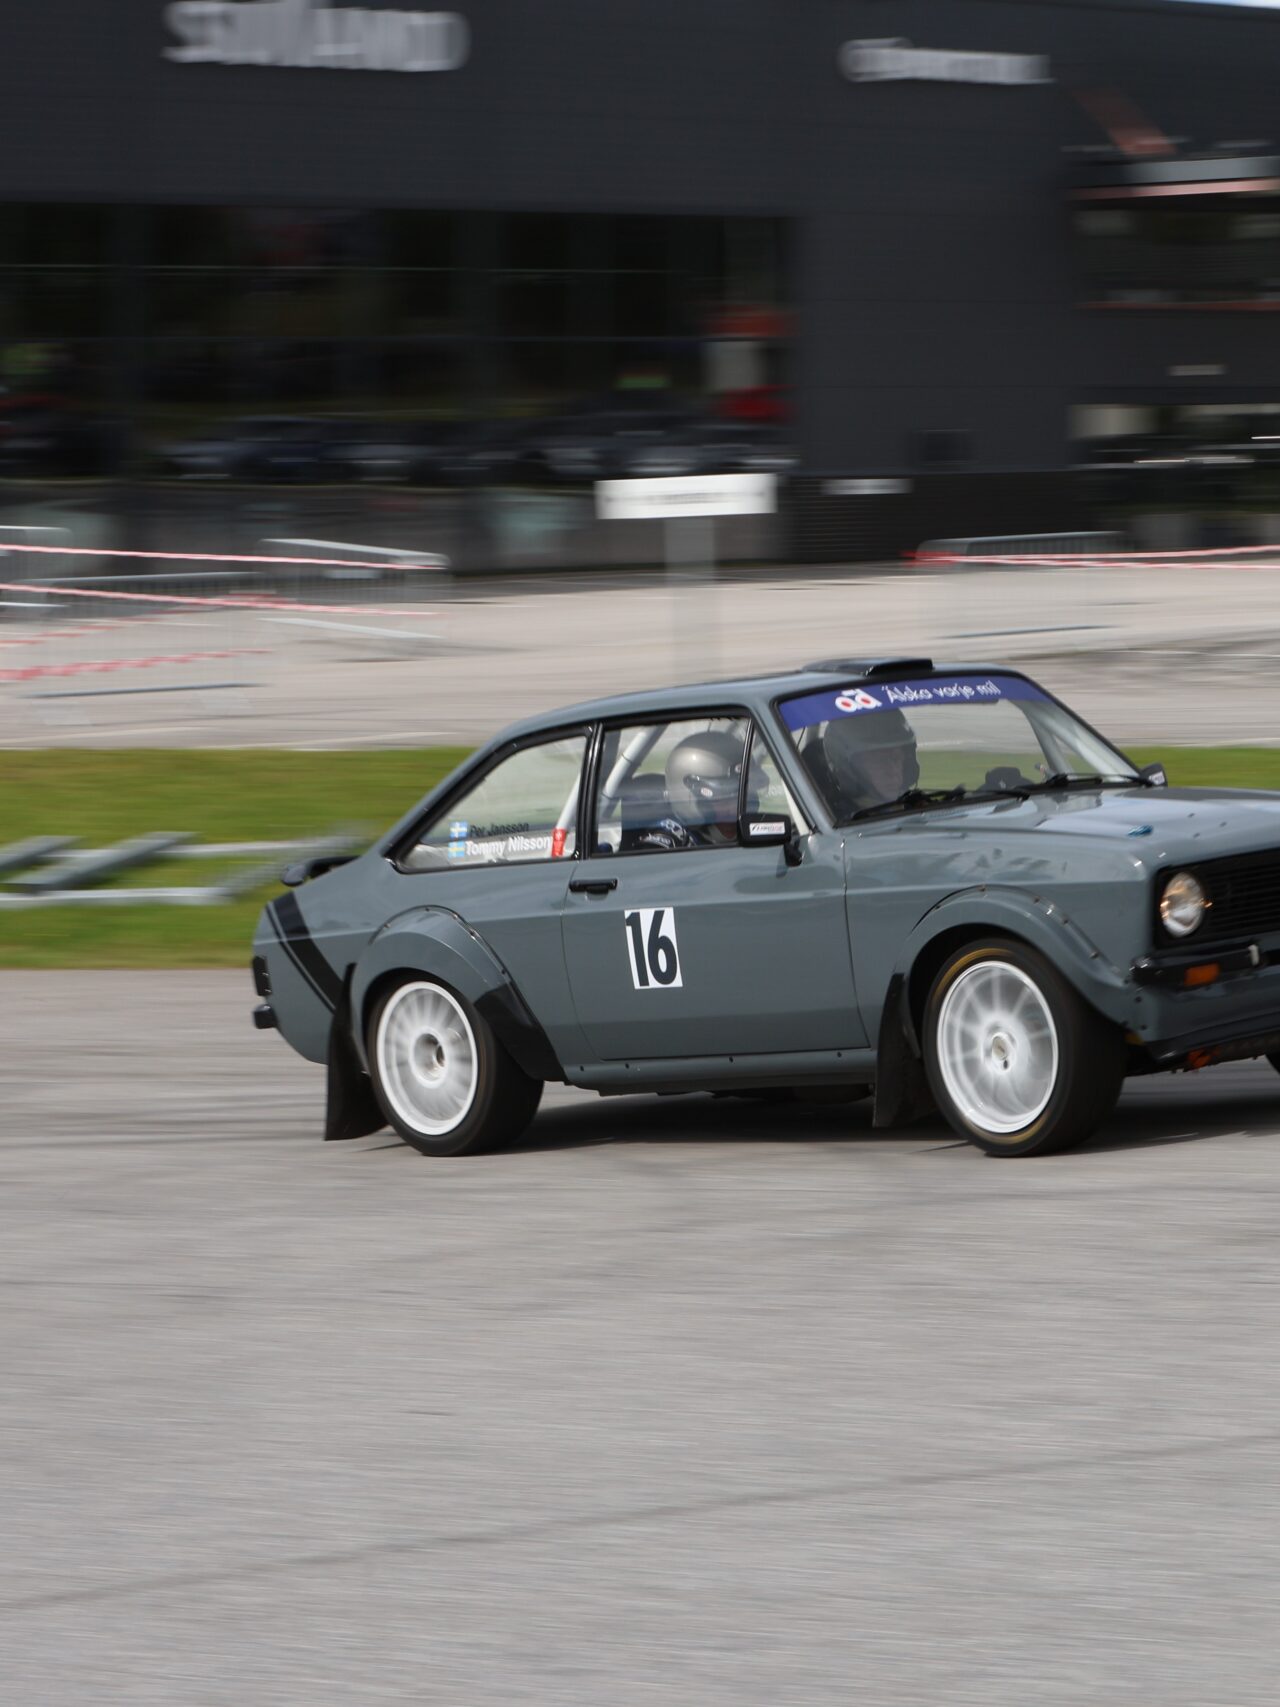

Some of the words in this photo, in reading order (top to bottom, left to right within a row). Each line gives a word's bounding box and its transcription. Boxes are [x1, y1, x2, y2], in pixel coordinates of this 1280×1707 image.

[933, 683, 974, 699] varje
[976, 680, 1001, 695] mil
[465, 841, 505, 857] Tommy
[508, 835, 553, 852] Nilsson
[625, 910, 677, 987] 16
